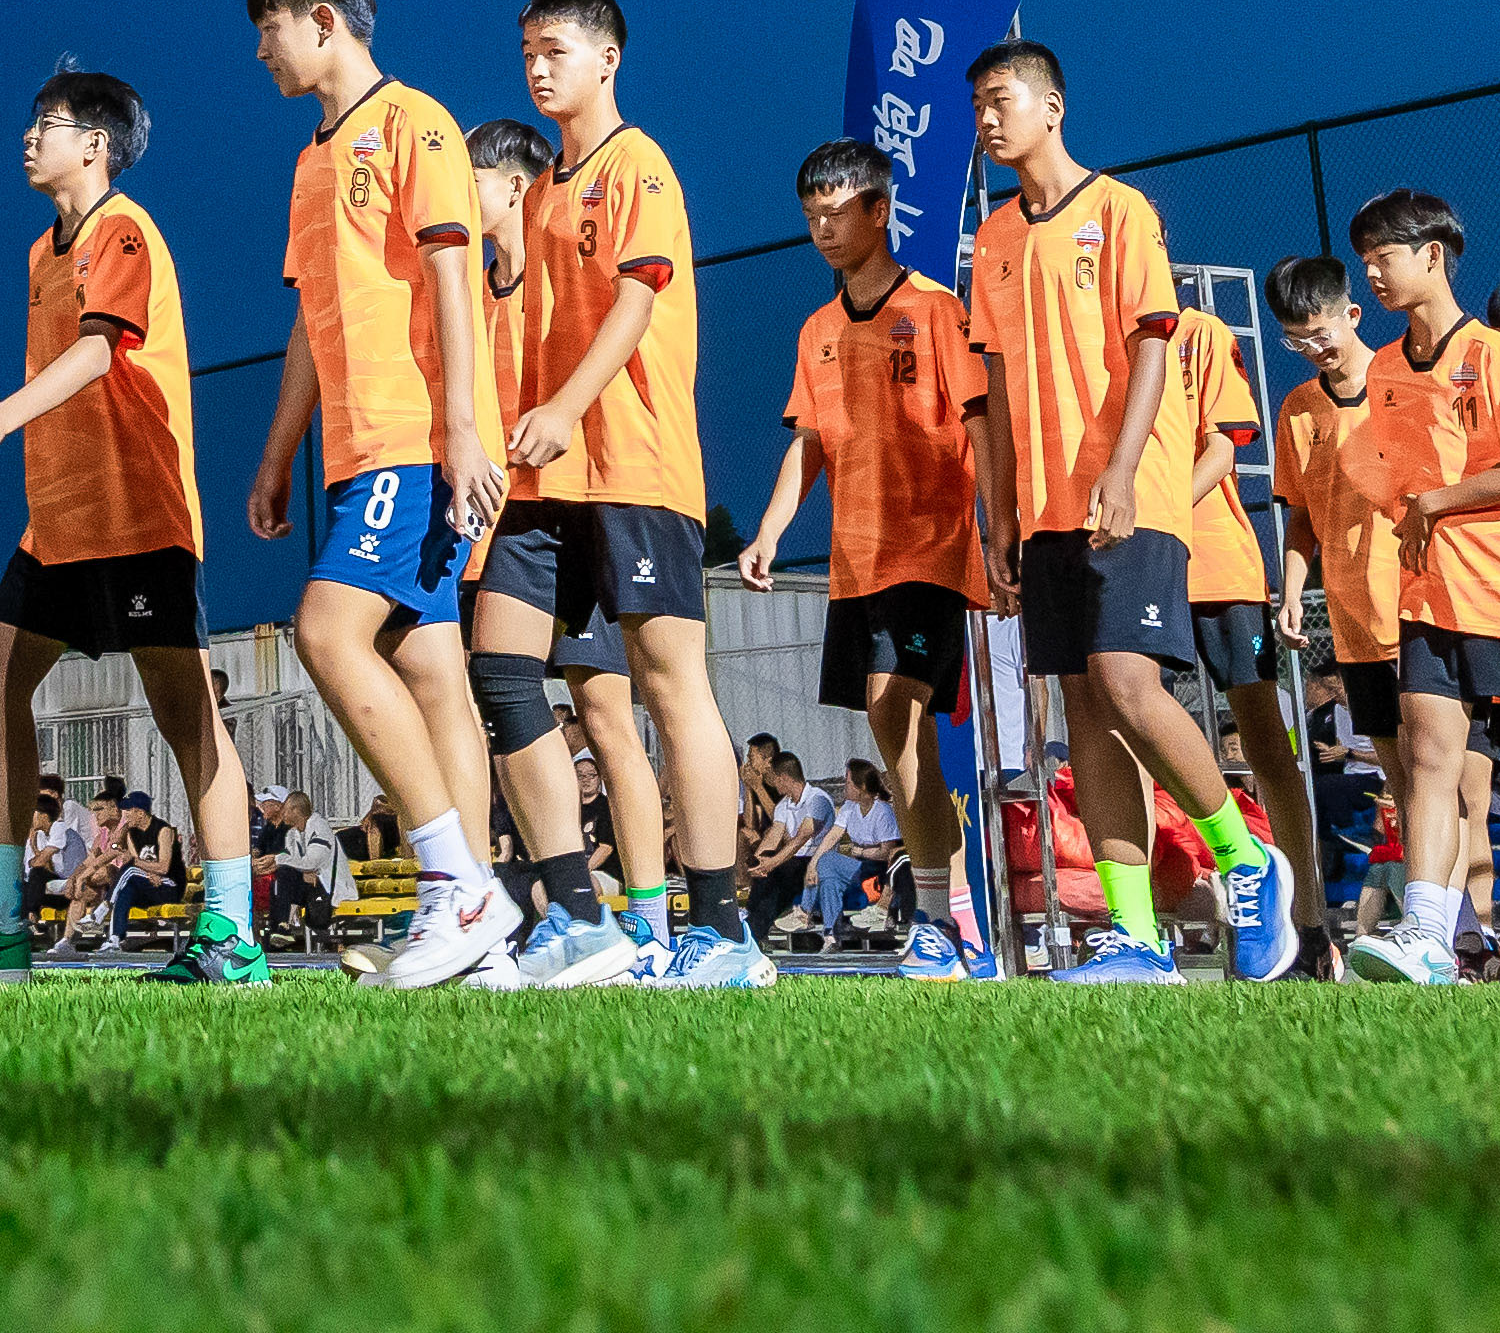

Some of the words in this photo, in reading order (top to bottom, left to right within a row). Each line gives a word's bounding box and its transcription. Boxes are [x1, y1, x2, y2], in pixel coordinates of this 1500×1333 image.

[350, 167, 371, 208] 8
[578, 219, 597, 258] 3
[1075, 256, 1095, 290] 6
[889, 348, 917, 384] 12
[1452, 396, 1478, 432] 11
[363, 470, 401, 531] 8
